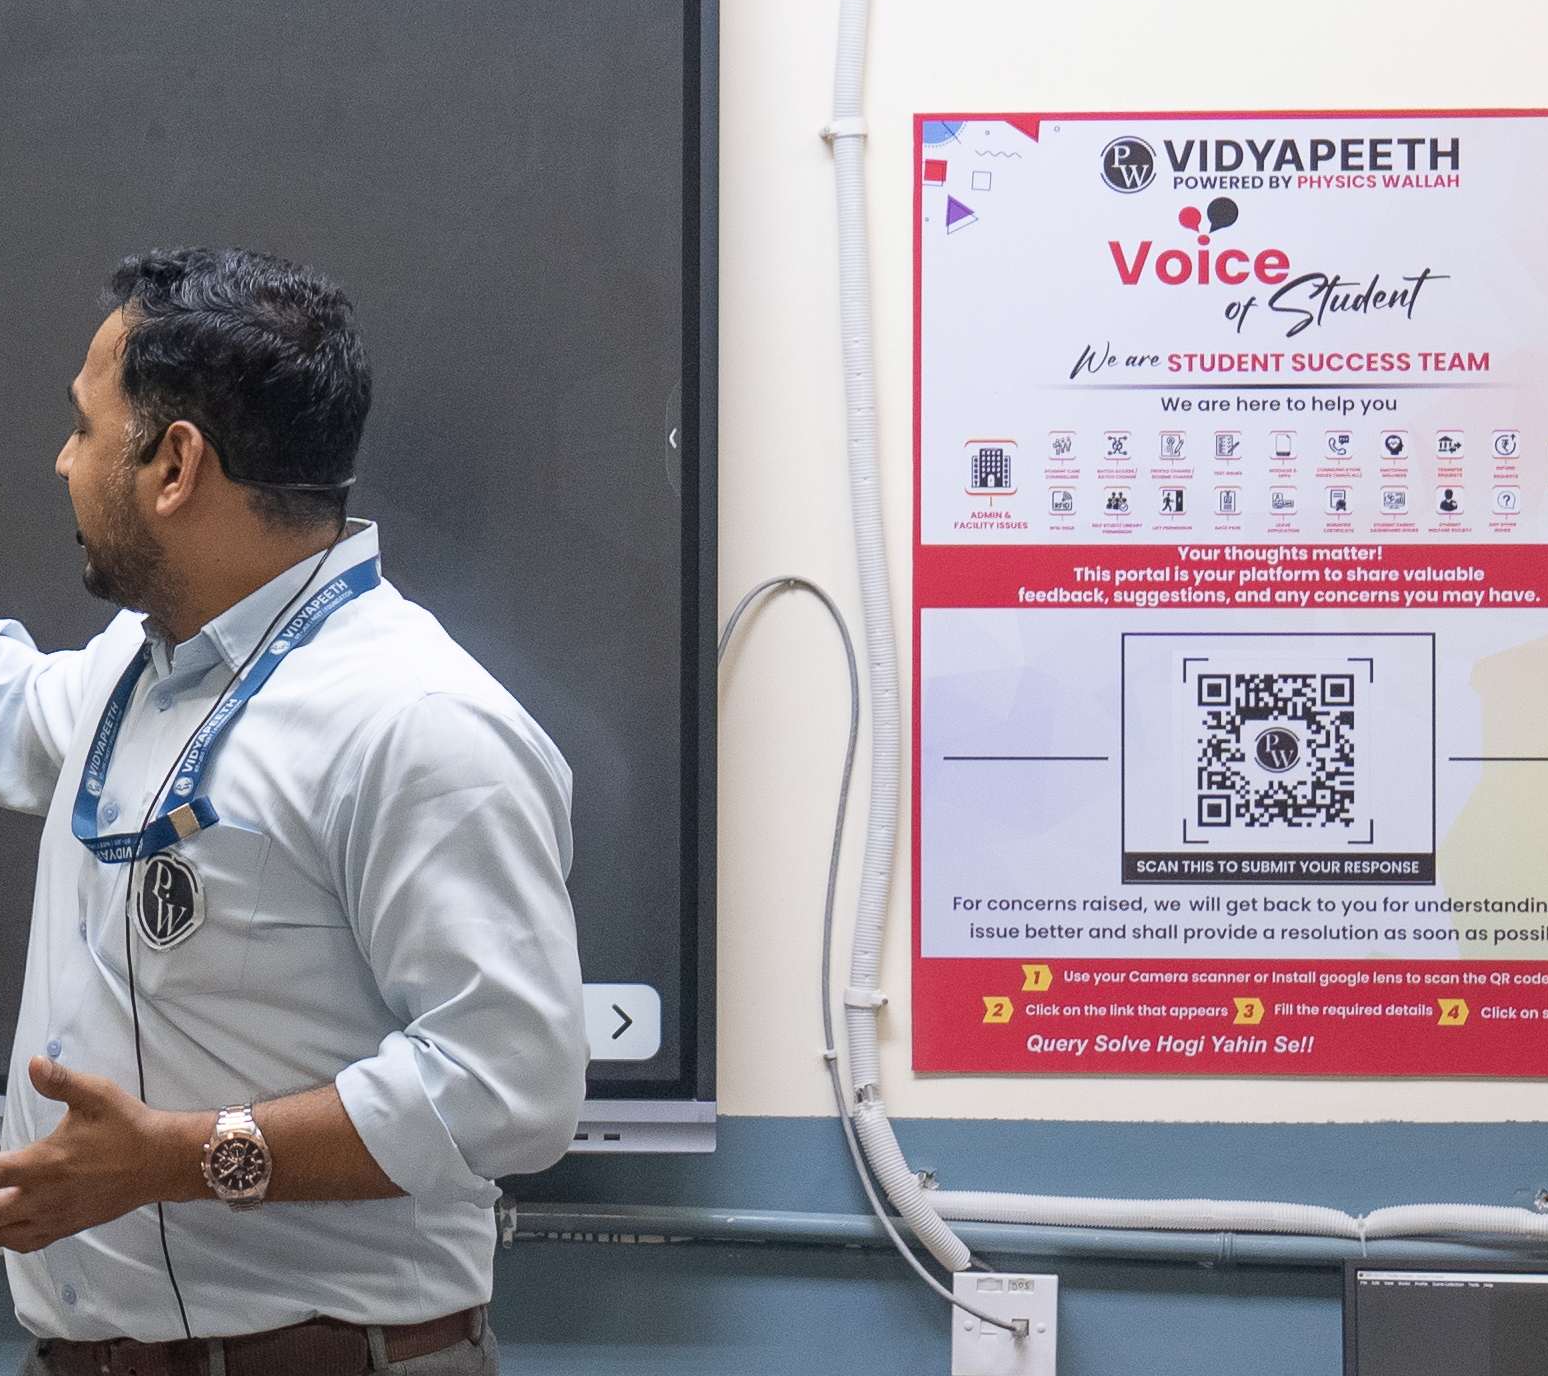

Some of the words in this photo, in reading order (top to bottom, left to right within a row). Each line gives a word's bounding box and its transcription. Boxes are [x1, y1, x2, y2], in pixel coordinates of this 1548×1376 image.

[1163, 137, 1460, 173] VIDYAPEETH
[1173, 175, 1264, 190] POWERED
[1268, 175, 1293, 190] BY
[1297, 174, 1377, 189] PHYSICS
[1382, 174, 1460, 188] WALLAH
[1108, 234, 1290, 285] Voice
[1224, 296, 1258, 334] of
[1269, 267, 1451, 338] Student
[1069, 340, 1117, 380] We
[1125, 354, 1160, 367] are
[1167, 353, 1285, 373] STUDENT
[1291, 352, 1411, 372] SUCCESS
[1417, 352, 1490, 372] TEAM
[1160, 397, 1193, 412] We
[1197, 399, 1231, 412] are
[1236, 396, 1281, 412] here
[1286, 396, 1306, 412] to
[1311, 395, 1355, 416] help
[1360, 399, 1397, 416] you
[953, 521, 995, 529] FACILITY
[996, 521, 1029, 529] ISSUES
[970, 511, 1002, 519] ADMIN
[1177, 546, 1221, 561] Your
[1223, 545, 1309, 565] thoughts
[1312, 545, 1383, 561] matter!
[1073, 565, 1111, 582] This
[1114, 566, 1171, 586] portal
[1174, 565, 1190, 582] is
[1192, 569, 1236, 586] your
[1239, 565, 1320, 586] platform
[1323, 567, 1343, 582] to
[1346, 566, 1400, 582] share
[1403, 566, 1485, 582] valuable
[1017, 586, 1109, 605] feedback,
[1113, 586, 1231, 607] suggestions,
[1234, 587, 1271, 603] and
[1274, 590, 1311, 607] any
[1313, 590, 1400, 603] concerns
[1403, 590, 1439, 607] you
[1442, 590, 1485, 607] may
[1488, 587, 1541, 603] have.
[282, 578, 349, 639] VIDYAPEETH
[88, 700, 120, 777] VIDYAPEETH
[181, 697, 239, 774] VIDYAPEETH
[1135, 860, 1180, 873] SCAN
[1181, 860, 1215, 873] THIS
[1217, 860, 1239, 873] TO
[1240, 858, 1297, 873] SUBMIT
[1299, 858, 1341, 874] YOUR
[1344, 859, 1419, 876] RESPONSE
[1033, 970, 1041, 984] 1
[1063, 970, 1091, 983] Use
[1093, 972, 1127, 986] your
[1127, 970, 1189, 983] Camera
[1191, 972, 1251, 984] scanner
[1253, 972, 1269, 984] or
[1271, 971, 1317, 984] Install
[1318, 971, 1370, 988] google
[1371, 971, 1403, 984] lens
[1405, 972, 1422, 984] to
[1424, 974, 1460, 985] scan
[1462, 972, 1487, 985] the
[1489, 972, 1511, 986] QR
[993, 1003, 1004, 1017] 2
[1025, 1003, 1060, 1016] Click
[1062, 1006, 1081, 1016] on
[1083, 1004, 1107, 1017] the
[1109, 1003, 1135, 1017] link
[1137, 1004, 1167, 1017] that
[1169, 1006, 1229, 1021] appears
[1243, 1004, 1254, 1018] 3
[1274, 1002, 1294, 1016] Fill
[1296, 1003, 1320, 1016] the
[1322, 1002, 1383, 1020] required
[1384, 1003, 1433, 1016] details
[1026, 1034, 1089, 1057] Query
[1093, 1034, 1152, 1053] Solve
[1156, 1035, 1206, 1057] Hogi
[1211, 1035, 1268, 1053] Yahin
[1273, 1035, 1315, 1054] Se!!
